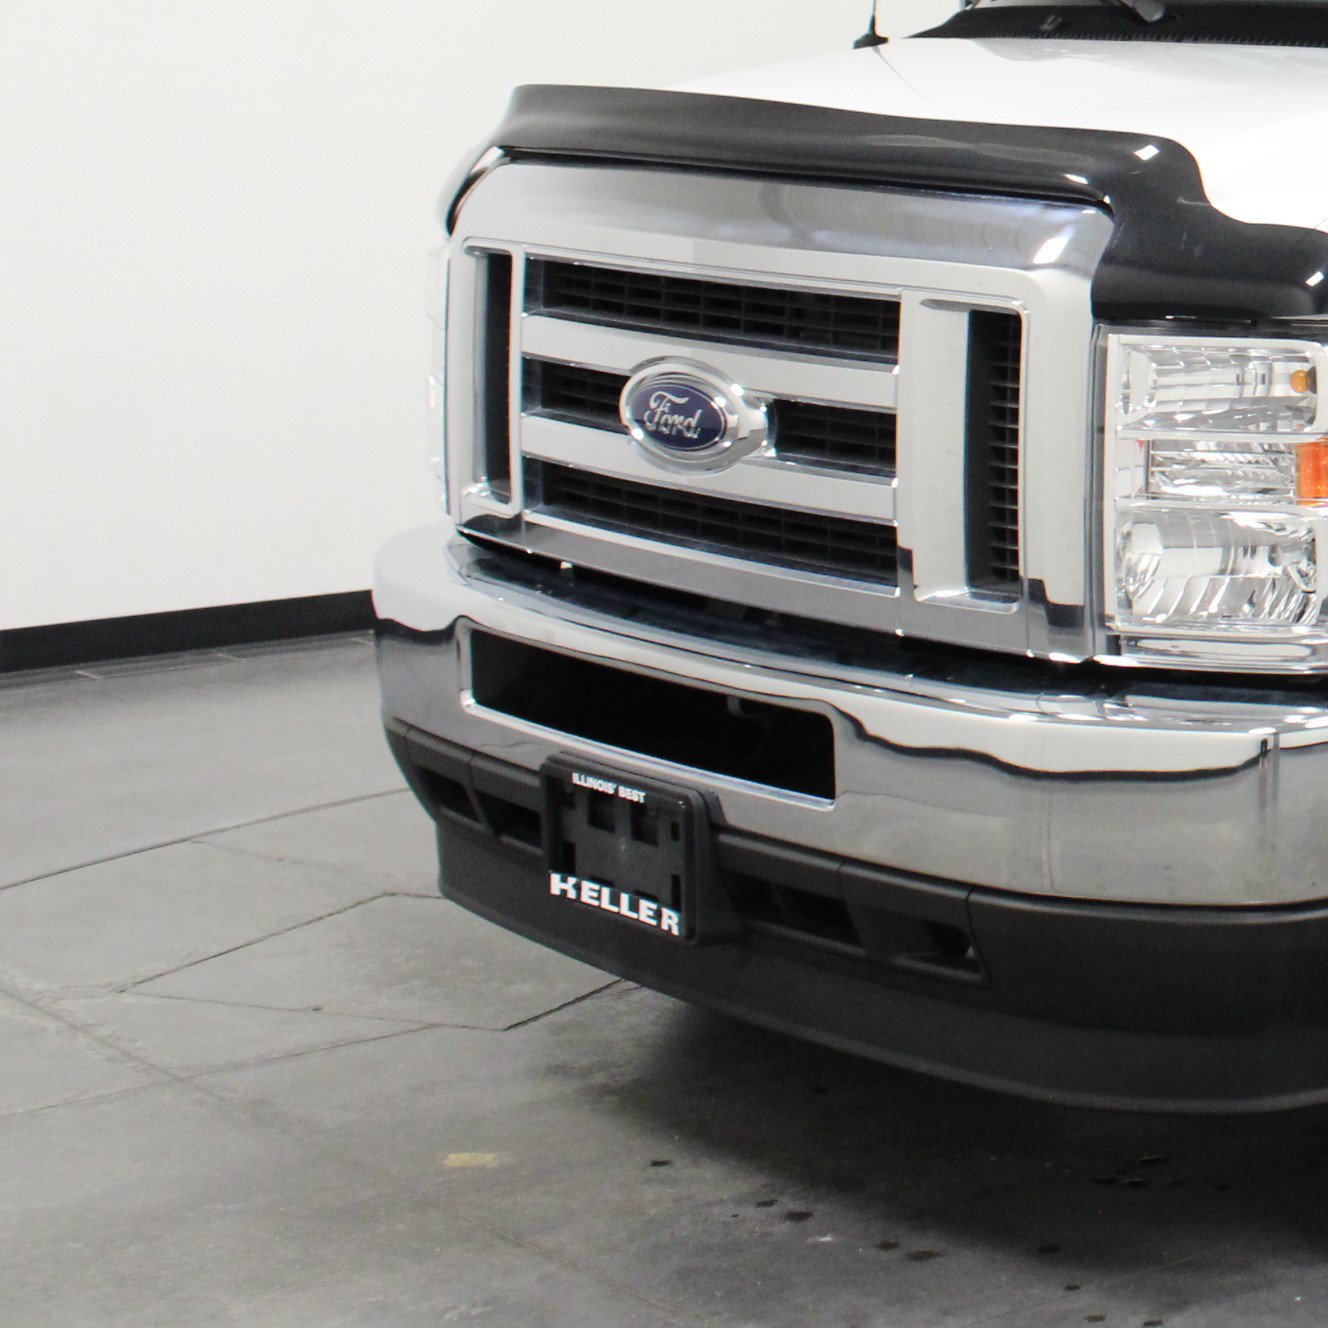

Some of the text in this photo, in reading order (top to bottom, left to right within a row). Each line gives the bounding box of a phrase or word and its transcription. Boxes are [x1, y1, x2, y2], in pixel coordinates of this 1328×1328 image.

[643, 389, 704, 440] Ford
[617, 784, 647, 804] BEST
[548, 870, 682, 937] KELLER
